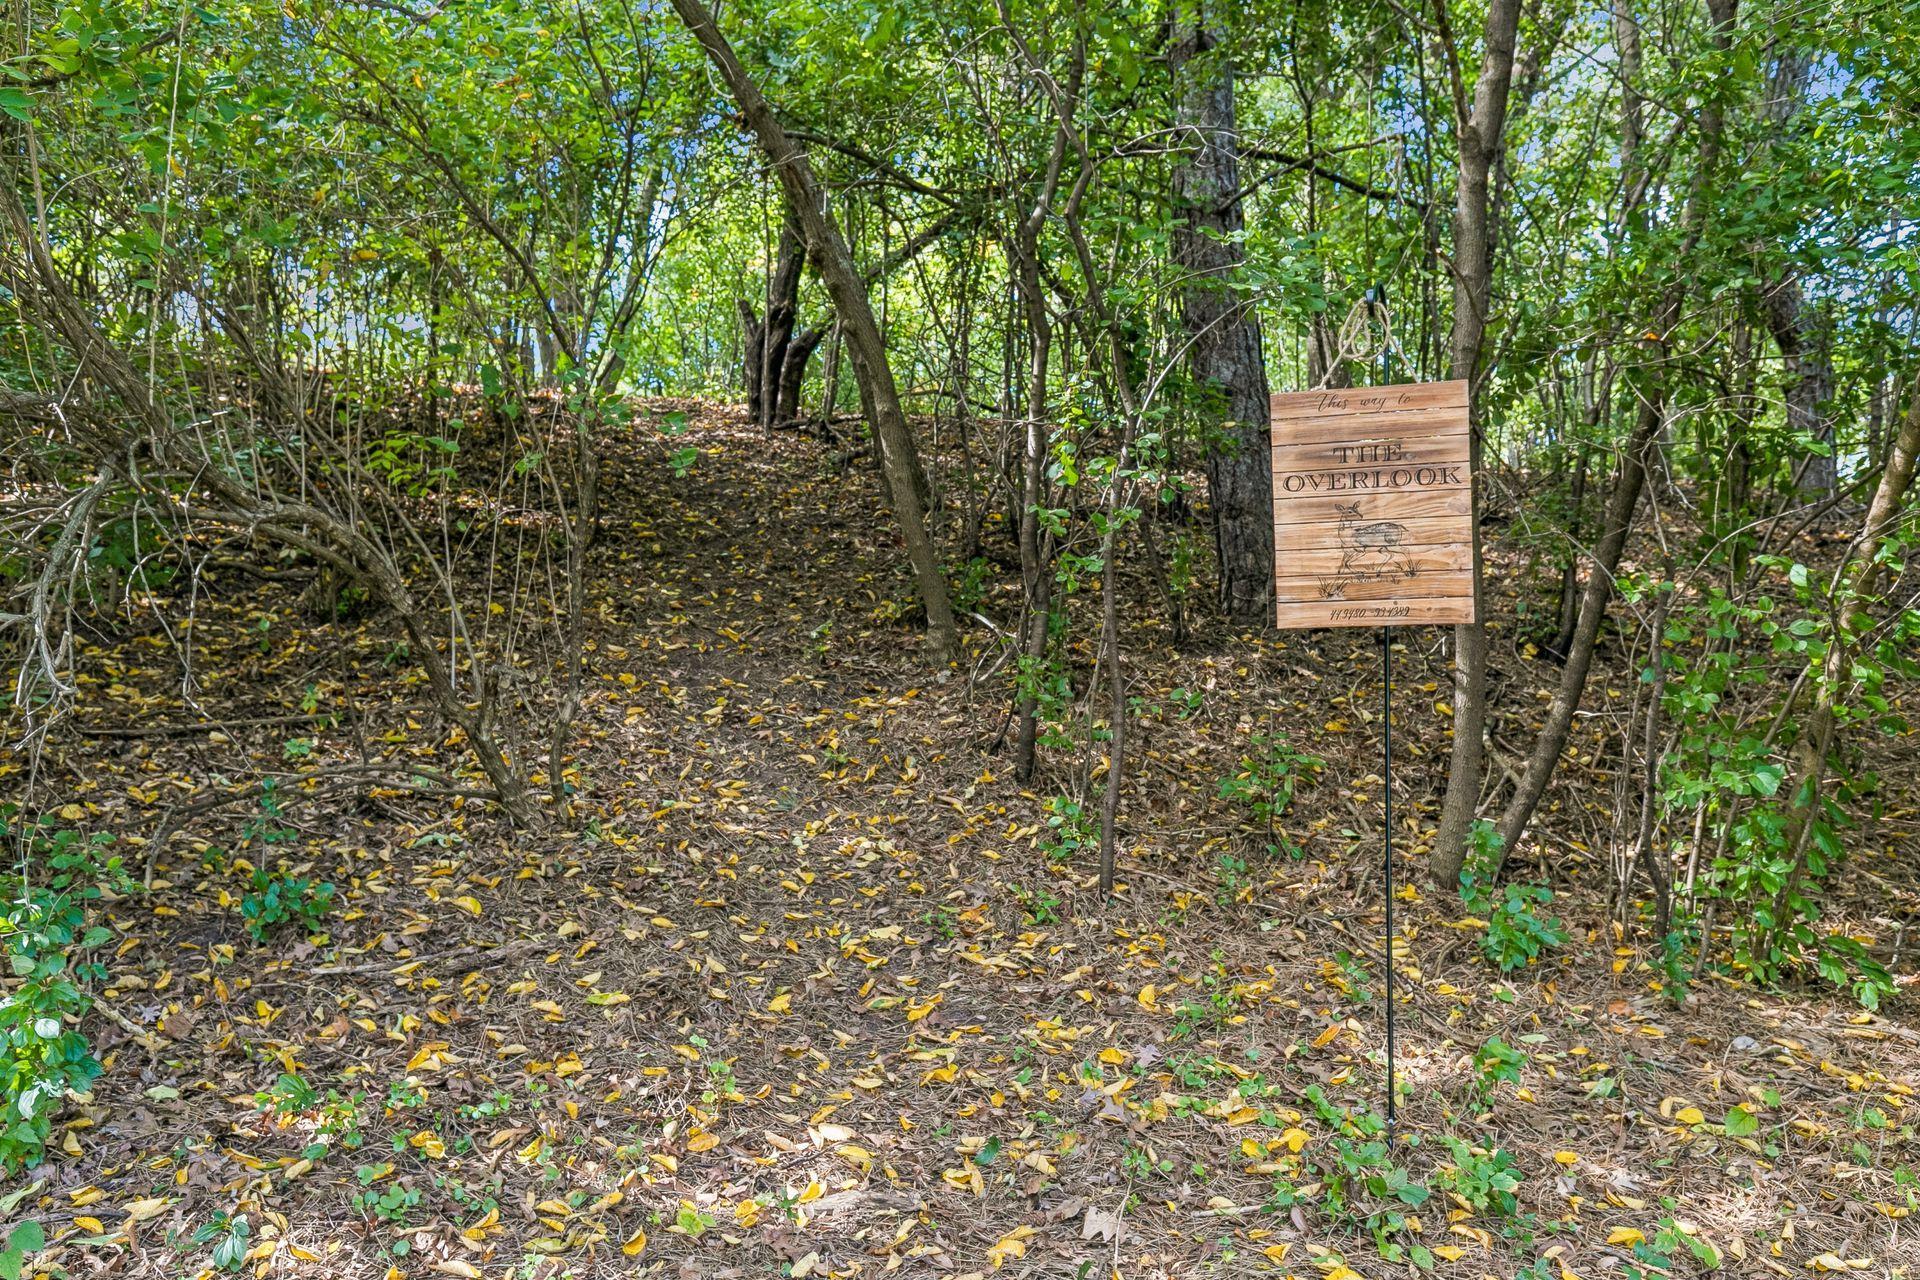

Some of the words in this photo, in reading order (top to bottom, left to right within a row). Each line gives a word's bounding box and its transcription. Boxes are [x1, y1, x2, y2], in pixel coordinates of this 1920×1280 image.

[1315, 392, 1350, 413] This
[1359, 397, 1386, 411] way
[1397, 392, 1411, 404] to
[1332, 443, 1402, 464] THE
[1282, 466, 1461, 492] OVERLOOK
